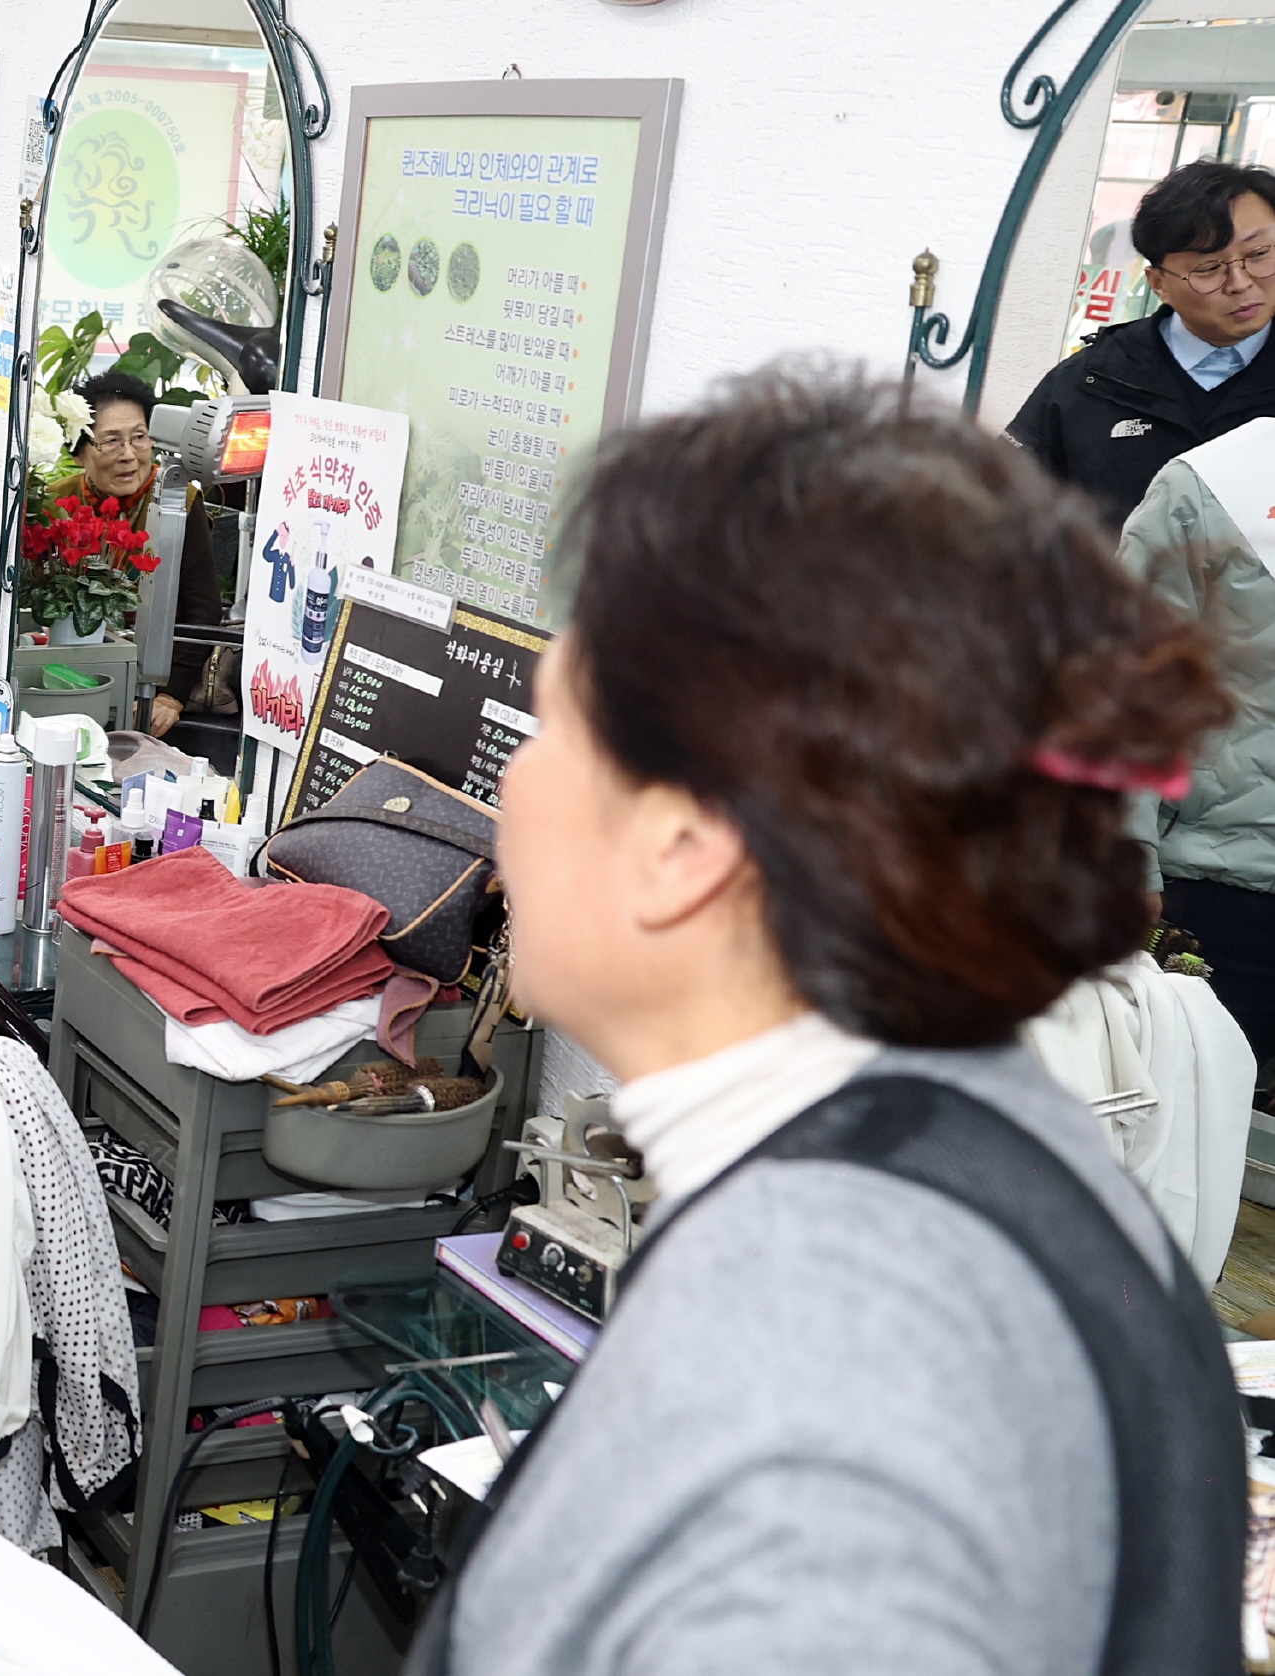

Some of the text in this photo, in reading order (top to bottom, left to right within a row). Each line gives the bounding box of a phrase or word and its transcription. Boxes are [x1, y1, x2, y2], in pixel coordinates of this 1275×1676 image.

[401, 149, 599, 186] 퀸즈헤나와 인체와의 관계로
[451, 189, 596, 227] 크리닉이 필요 할 때
[506, 267, 579, 296] 머리가 아플 때
[502, 299, 575, 329] 뒷목이 당길 때
[443, 323, 570, 362] 스트레스를 많이 받았을 때
[495, 362, 567, 395] 어깨가 아플 때
[449, 386, 562, 429] 피로가 누적되어 있을 때
[487, 426, 510, 447] 눈이
[545, 438, 558, 460] 때
[282, 454, 383, 531] 최초 식약처 인증
[483, 458, 553, 494] 비듬이 있을 때
[459, 483, 500, 511] 머리에서
[464, 516, 508, 543] 지루성이
[509, 527, 531, 553] 있는
[460, 545, 541, 590] 두피가 가려울 때
[477, 583, 499, 608] 열이
[444, 640, 504, 680] 석화미용실
[250, 686, 306, 740] 마끼라
